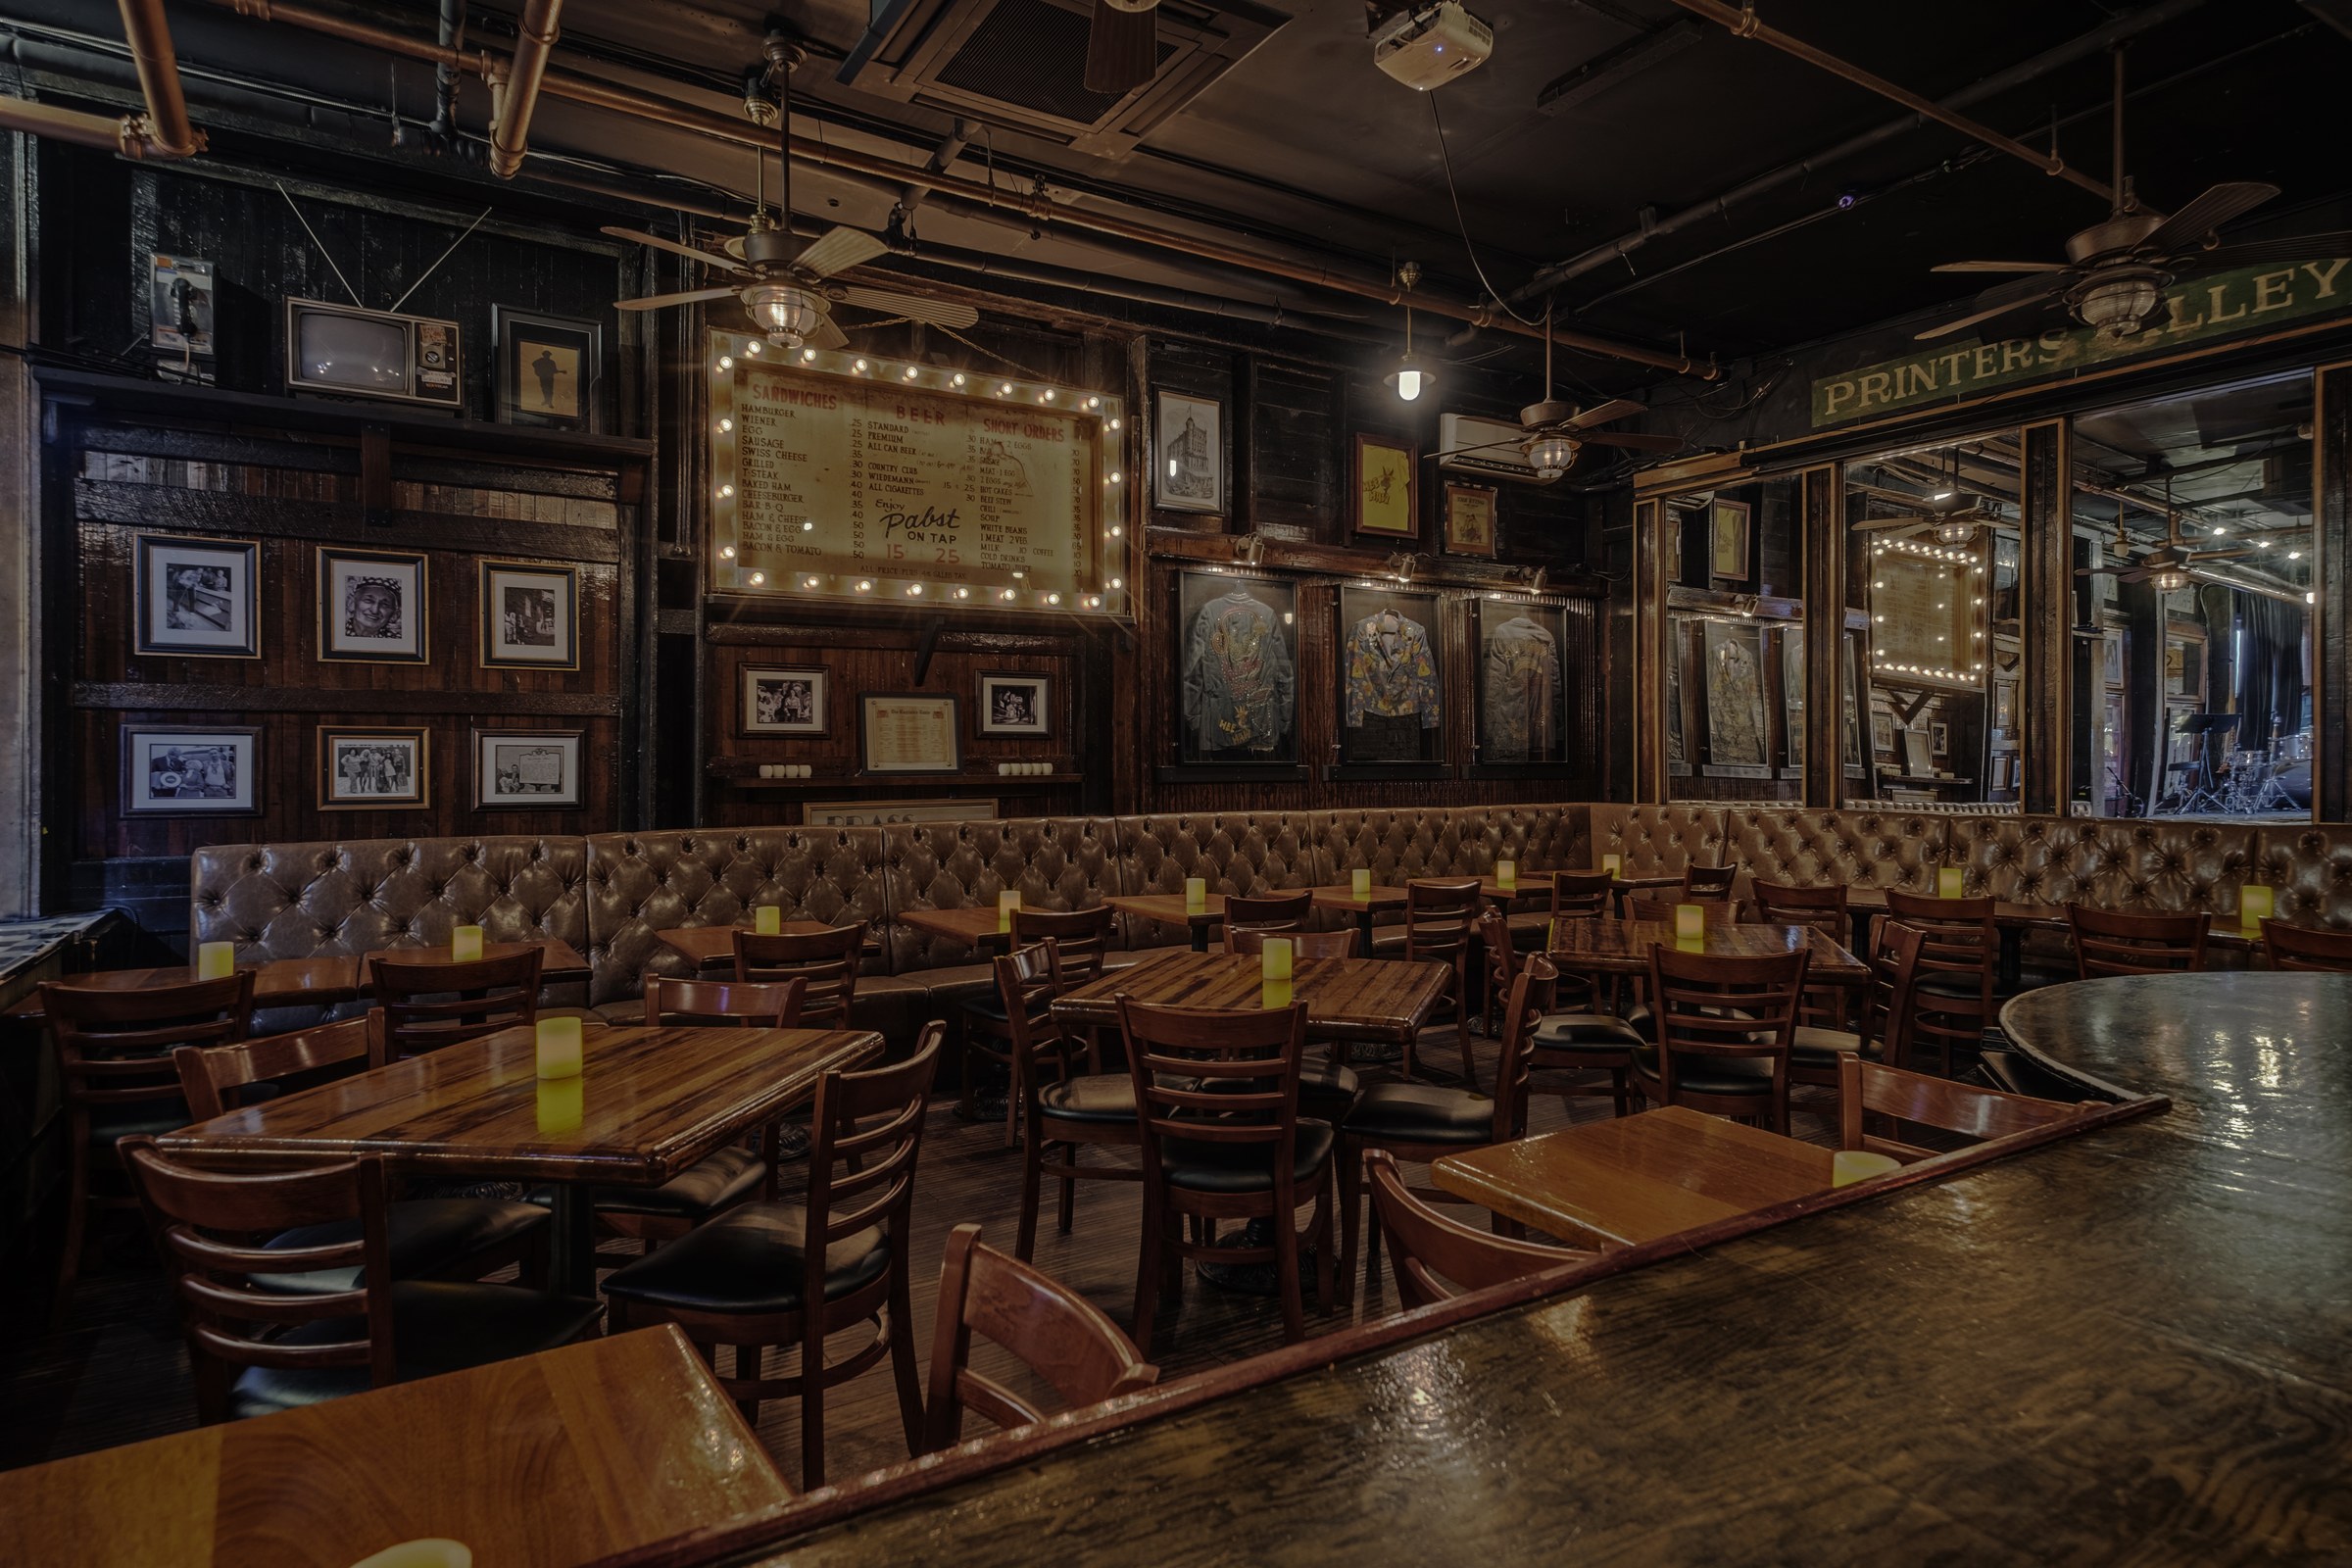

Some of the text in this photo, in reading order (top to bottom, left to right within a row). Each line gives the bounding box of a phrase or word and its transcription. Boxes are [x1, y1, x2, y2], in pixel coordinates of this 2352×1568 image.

[1825, 329, 2069, 416] PRINTERS
[753, 384, 836, 410] SANDWICHES
[741, 404, 796, 418] HAMBURGER
[897, 405, 946, 425] BEER
[741, 415, 777, 426] WIENER
[742, 425, 762, 435] EGG
[868, 421, 908, 433] STANDARD
[984, 418, 1064, 442] SHORT ORDERS
[742, 436, 784, 449] SAUSAGE
[868, 431, 904, 443] PREMIUM
[742, 447, 771, 457] SWISS
[776, 451, 808, 462] CHEESE
[742, 458, 773, 468] GRILLED
[868, 463, 898, 472] COUNTRY
[902, 466, 917, 474] CLUB
[980, 466, 995, 475] MEAT
[869, 472, 913, 484] WIEDEMANN
[986, 476, 1001, 485] EGGS
[742, 479, 768, 488] BAKED
[772, 482, 791, 491] HAM
[869, 483, 883, 492] ALL
[885, 484, 924, 496] CIGARETTES
[742, 490, 804, 503] CHEESEBURGER
[994, 487, 1012, 496] CAKES
[875, 498, 905, 513] Enjoy
[742, 512, 763, 520] HAM
[778, 515, 808, 524] CHEESE
[879, 506, 960, 539] Pabst
[743, 522, 772, 531] BACON
[743, 532, 762, 541] HAM
[907, 531, 956, 544] ON TAP
[985, 534, 1004, 543] MEAT
[743, 541, 772, 552] BACON
[786, 544, 821, 556] TOMATO
[980, 543, 1000, 552] MILK
[1001, 554, 1025, 563] DRINKS
[860, 564, 874, 573] ALL
[981, 562, 1010, 570] TOMATO
